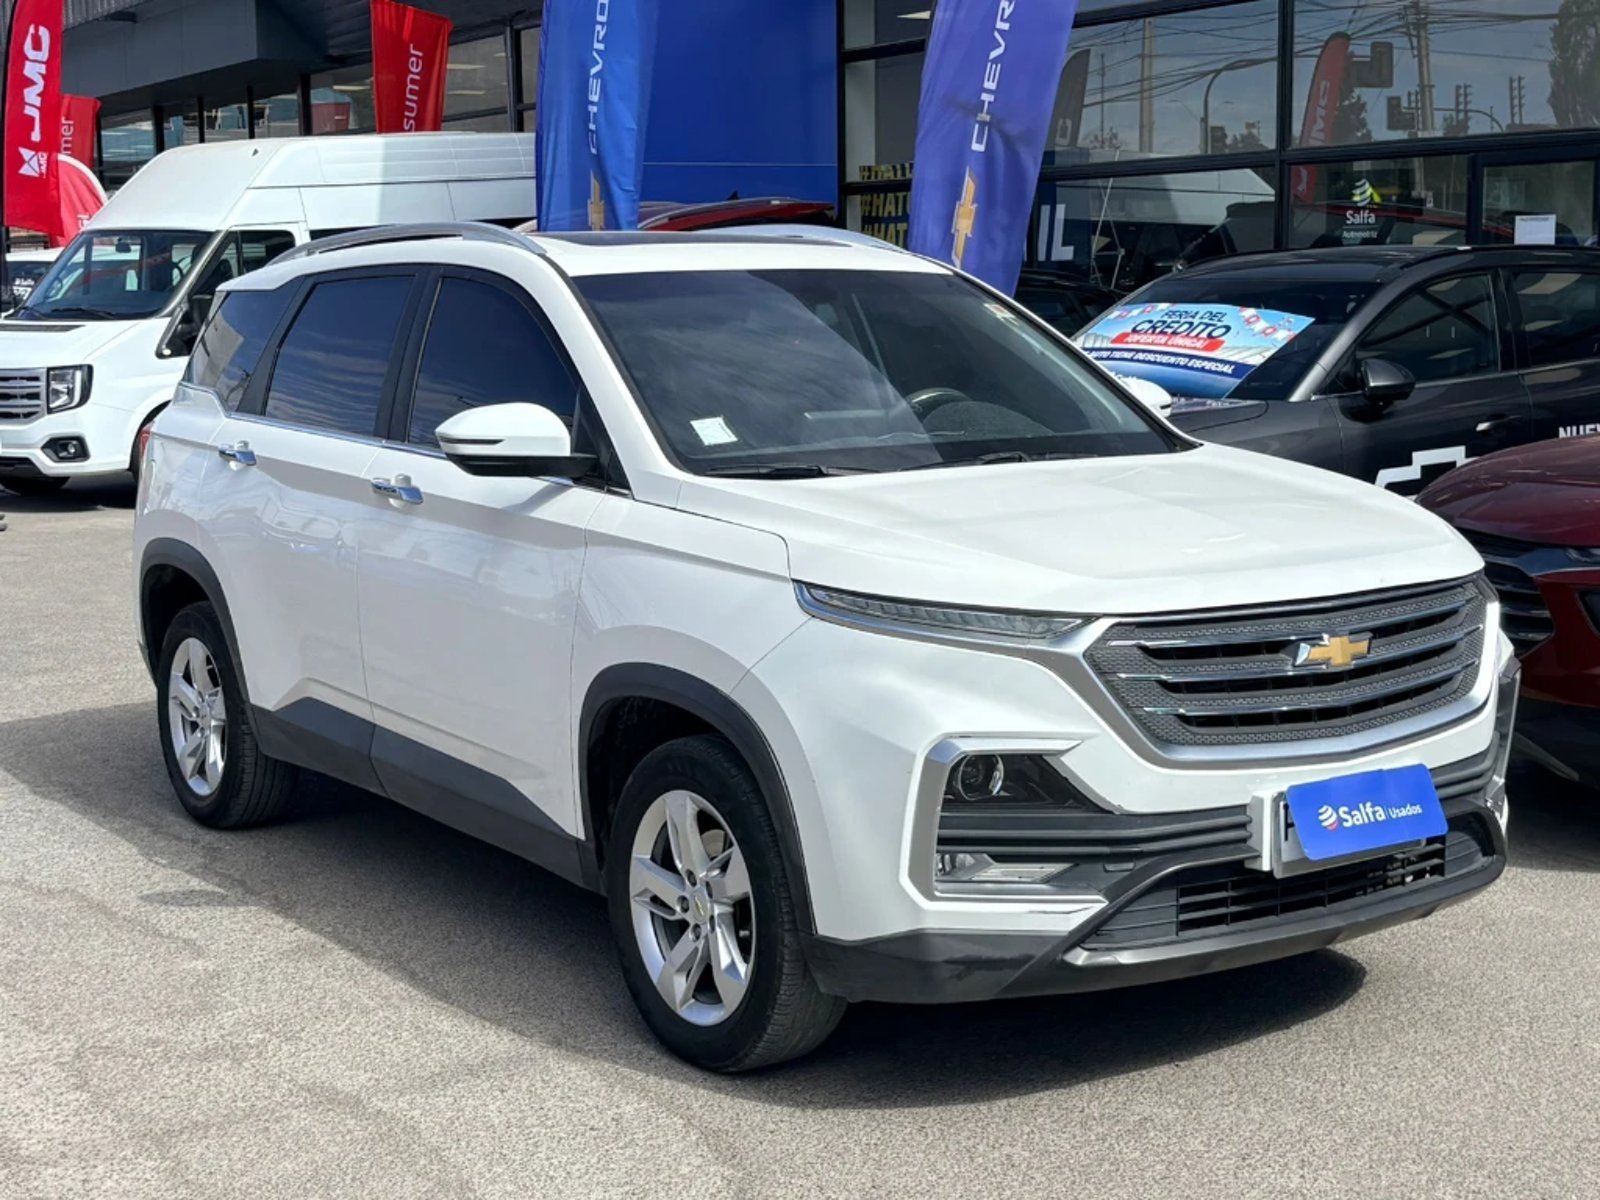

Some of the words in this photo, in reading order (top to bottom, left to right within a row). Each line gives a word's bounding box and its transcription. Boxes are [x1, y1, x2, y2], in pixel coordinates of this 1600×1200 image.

[23, 23, 50, 142] JMC
[403, 43, 424, 132] sumer
[61, 116, 74, 154] mer
[861, 192, 912, 217] #HAT
[1345, 209, 1376, 224] Salfa
[1024, 204, 1074, 261] IL
[1161, 310, 1199, 320] FERIA
[1200, 310, 1227, 323] DEL
[1187, 359, 1235, 374] ESPECIAL
[1338, 801, 1387, 828] Salfa
[1388, 803, 1423, 820] Usados
